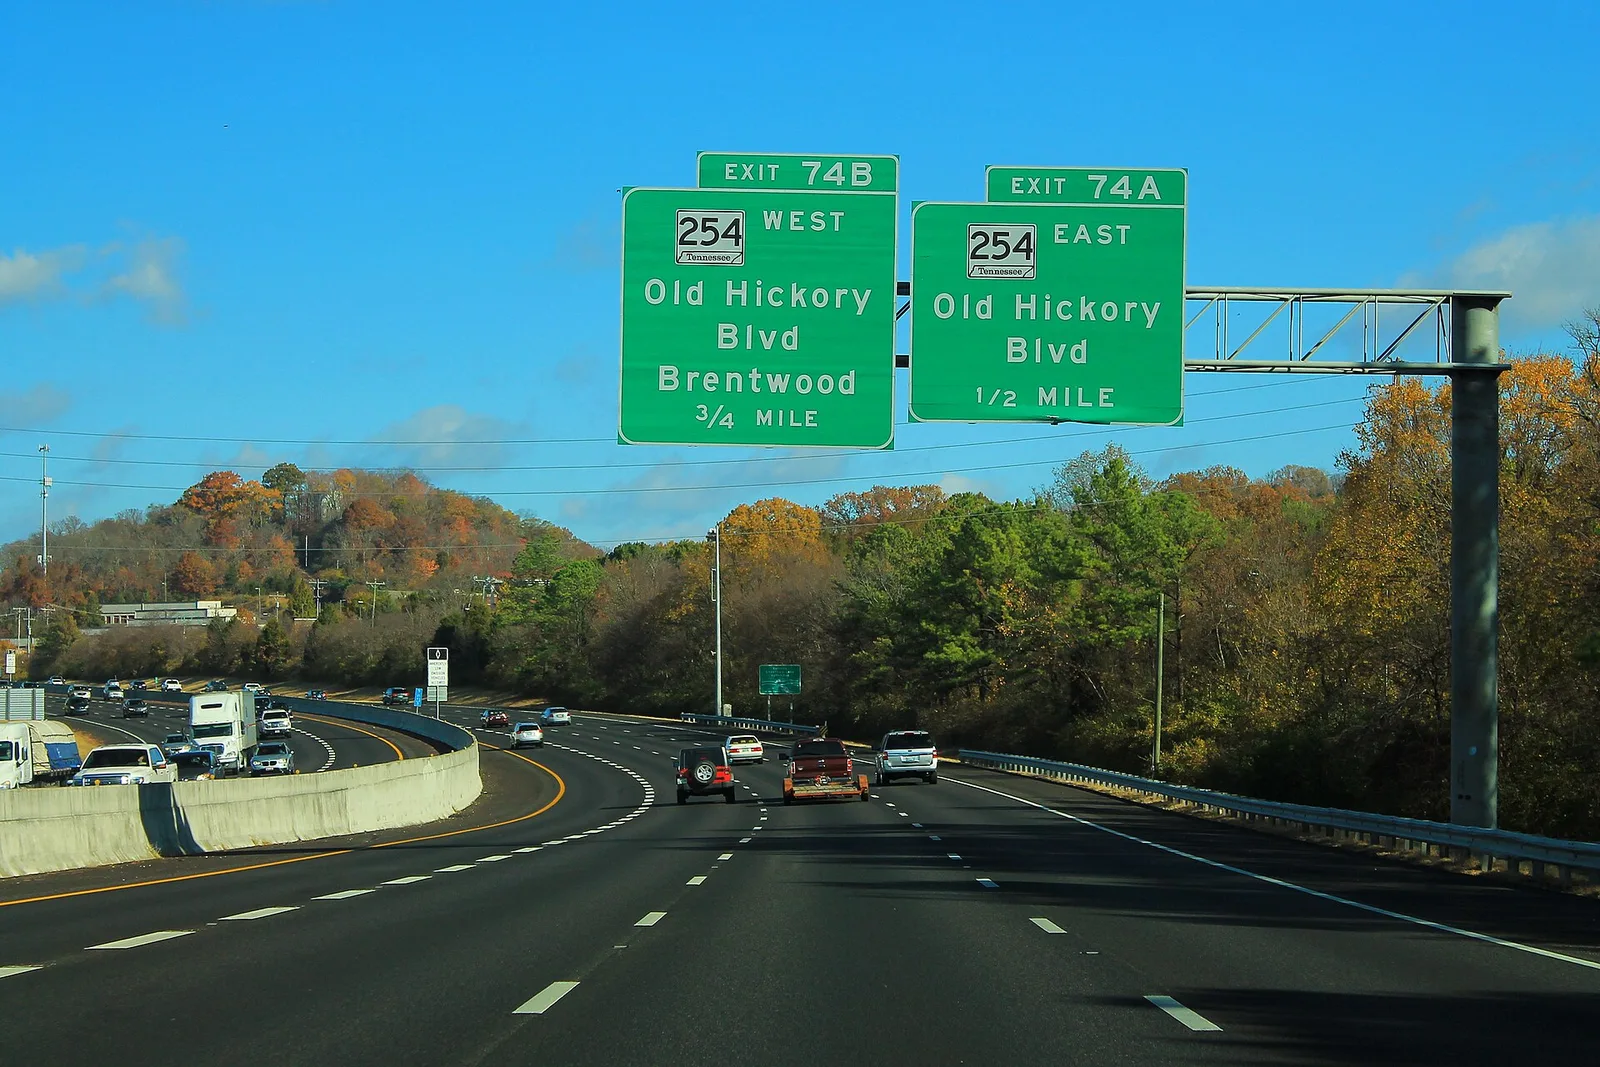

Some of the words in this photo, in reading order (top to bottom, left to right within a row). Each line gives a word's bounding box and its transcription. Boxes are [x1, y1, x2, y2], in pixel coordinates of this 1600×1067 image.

[725, 163, 780, 181] EXIT
[801, 161, 873, 187] 74B
[1011, 177, 1066, 195] EXIT
[1087, 174, 1162, 200] 74A
[678, 216, 742, 247] 254
[762, 210, 845, 232] WEST
[1054, 223, 1131, 245] EAST
[686, 253, 731, 262] Tennessee
[969, 231, 1033, 261] 254
[978, 267, 1023, 276] Tennessee
[644, 278, 704, 306] Old
[726, 279, 872, 315] Hickory
[933, 292, 993, 320] Old
[1015, 293, 1161, 329] Hickory
[717, 323, 799, 351] Blvd
[1007, 336, 1087, 364] Blvd
[658, 365, 855, 395] Brentwood
[976, 386, 1017, 408] 1/2
[1038, 386, 1115, 408] MILE
[695, 404, 735, 429] 3/4
[756, 409, 819, 427] MILE
